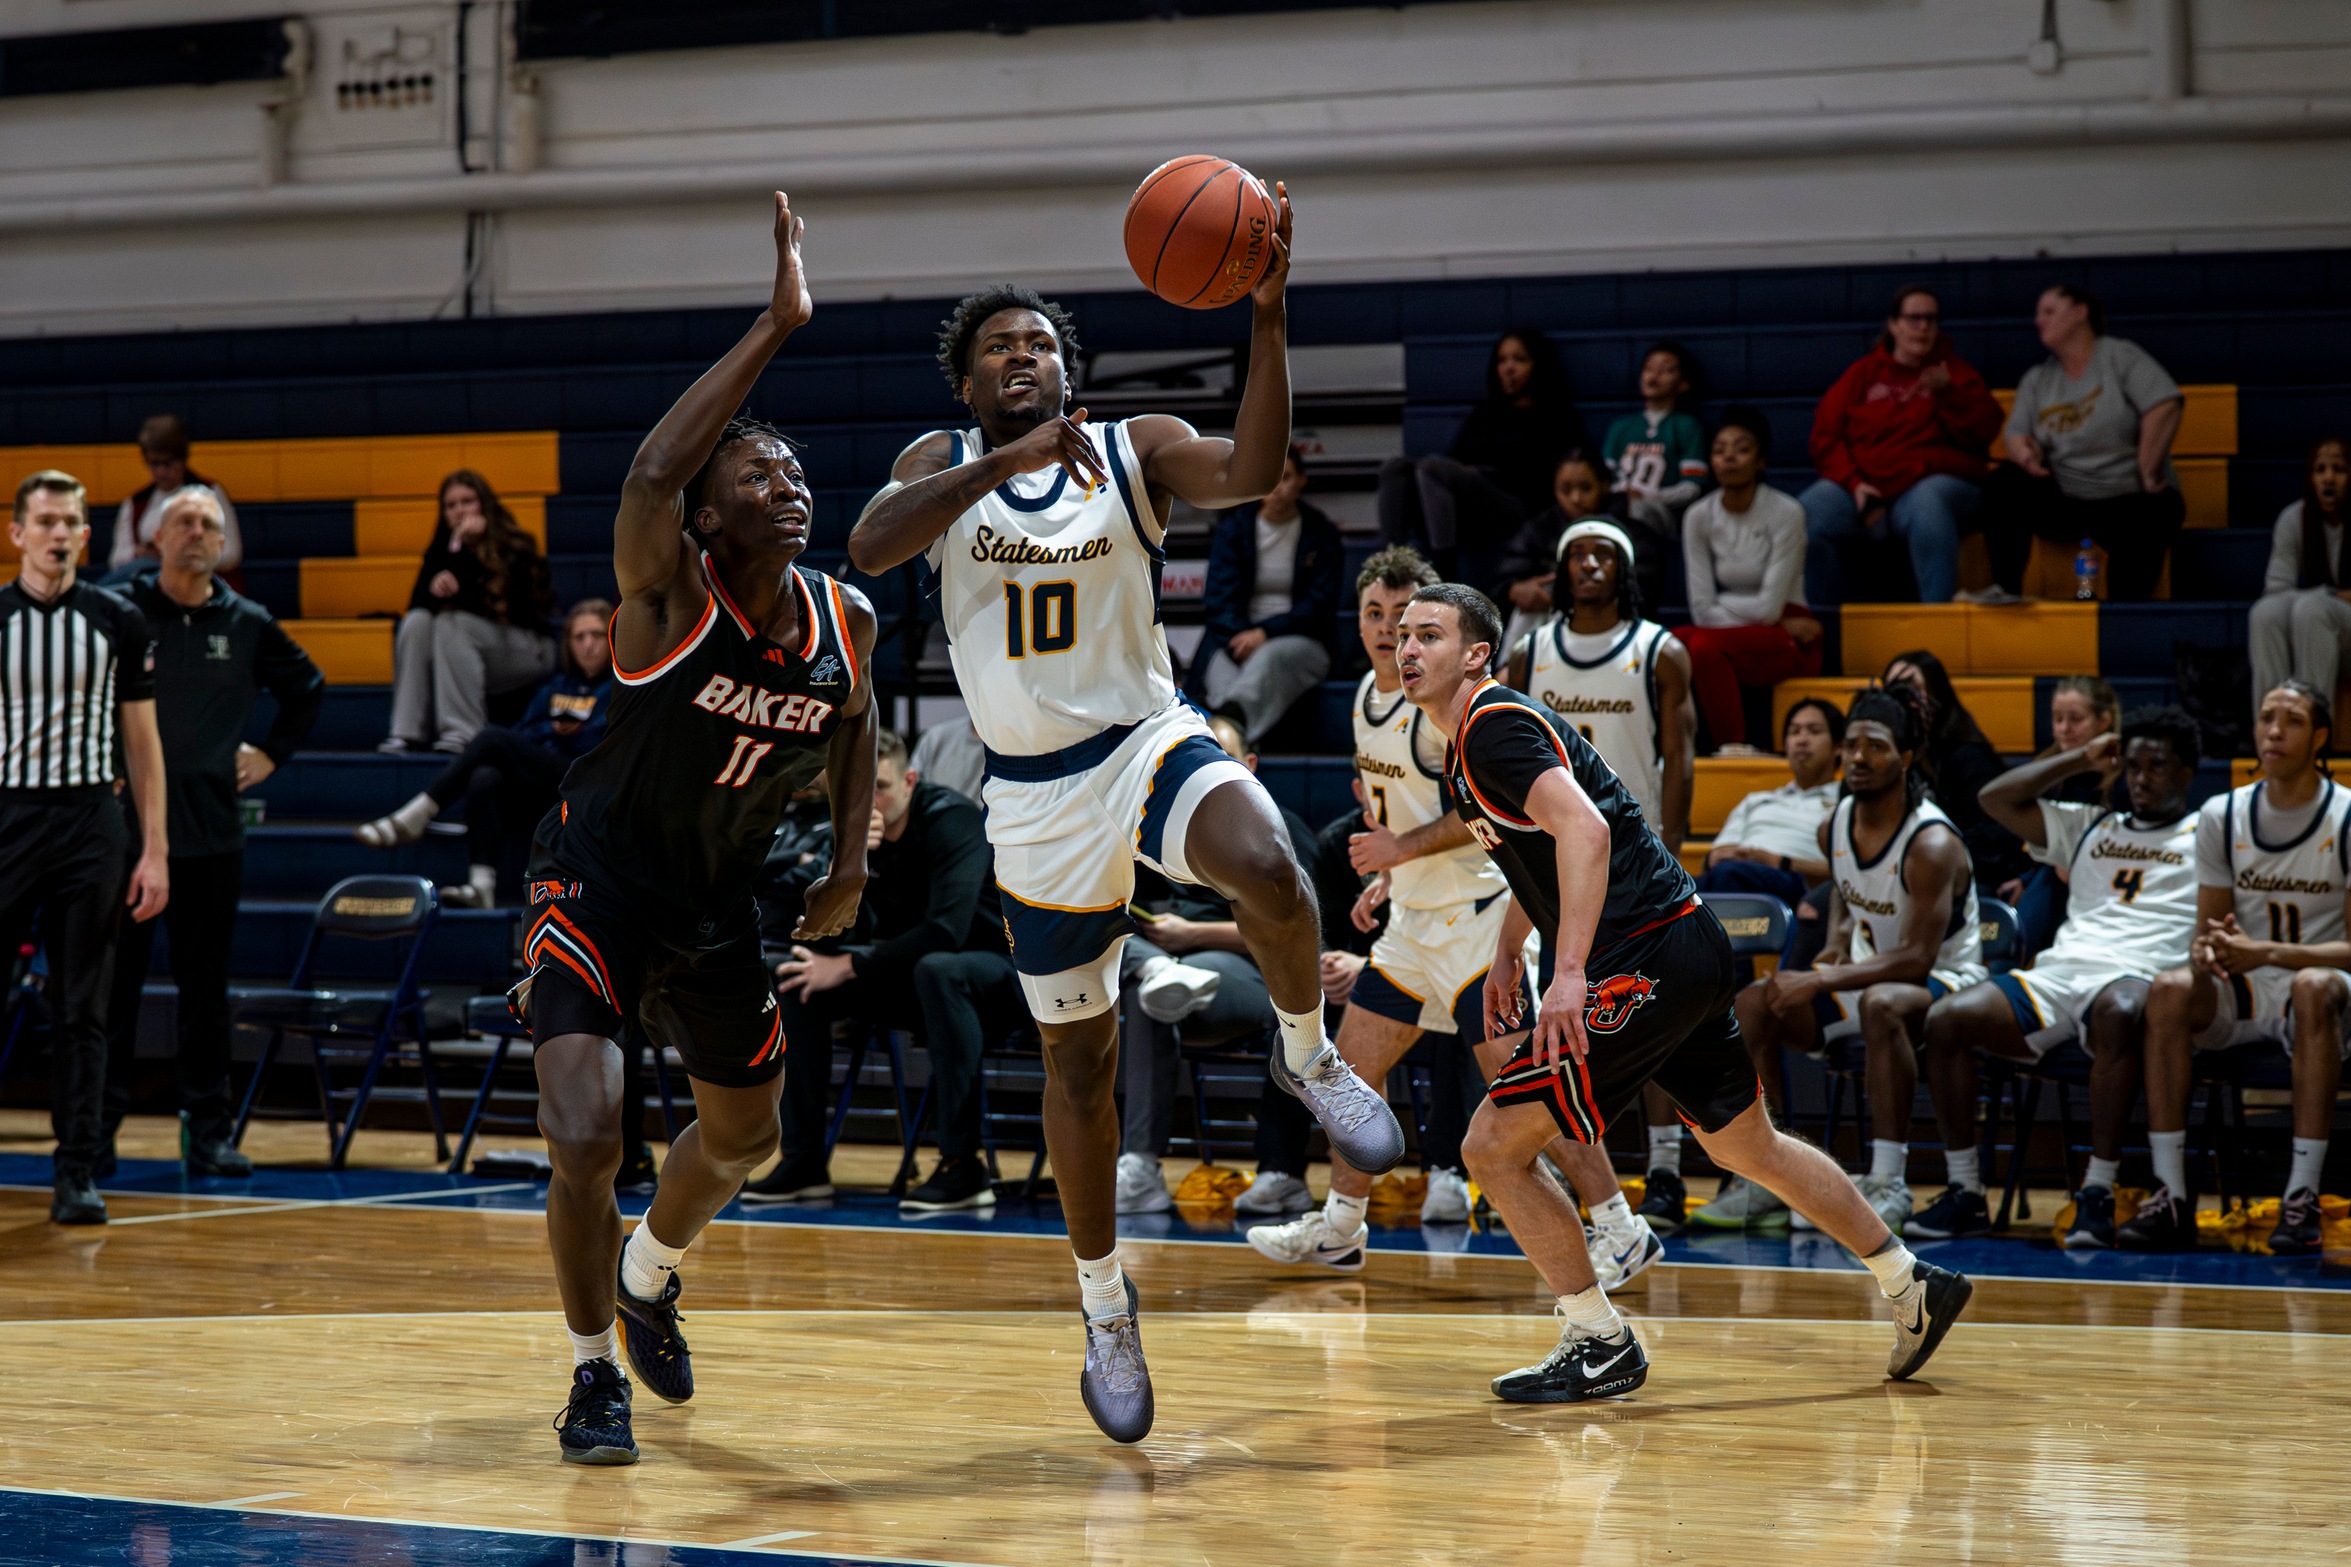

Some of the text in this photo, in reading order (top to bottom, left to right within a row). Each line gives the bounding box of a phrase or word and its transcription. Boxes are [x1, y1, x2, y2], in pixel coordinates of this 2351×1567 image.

[971, 524, 1113, 564] Statesmen
[1003, 579, 1078, 660] 10
[692, 673, 834, 734] BAKER
[1542, 690, 1635, 714] Statesmen
[713, 735, 774, 788] 11
[1371, 784, 1389, 829] 7
[2090, 838, 2184, 865] Statesmen
[2111, 868, 2144, 905] 4
[2237, 869, 2331, 894] Statesmen
[2268, 901, 2302, 944] 11
